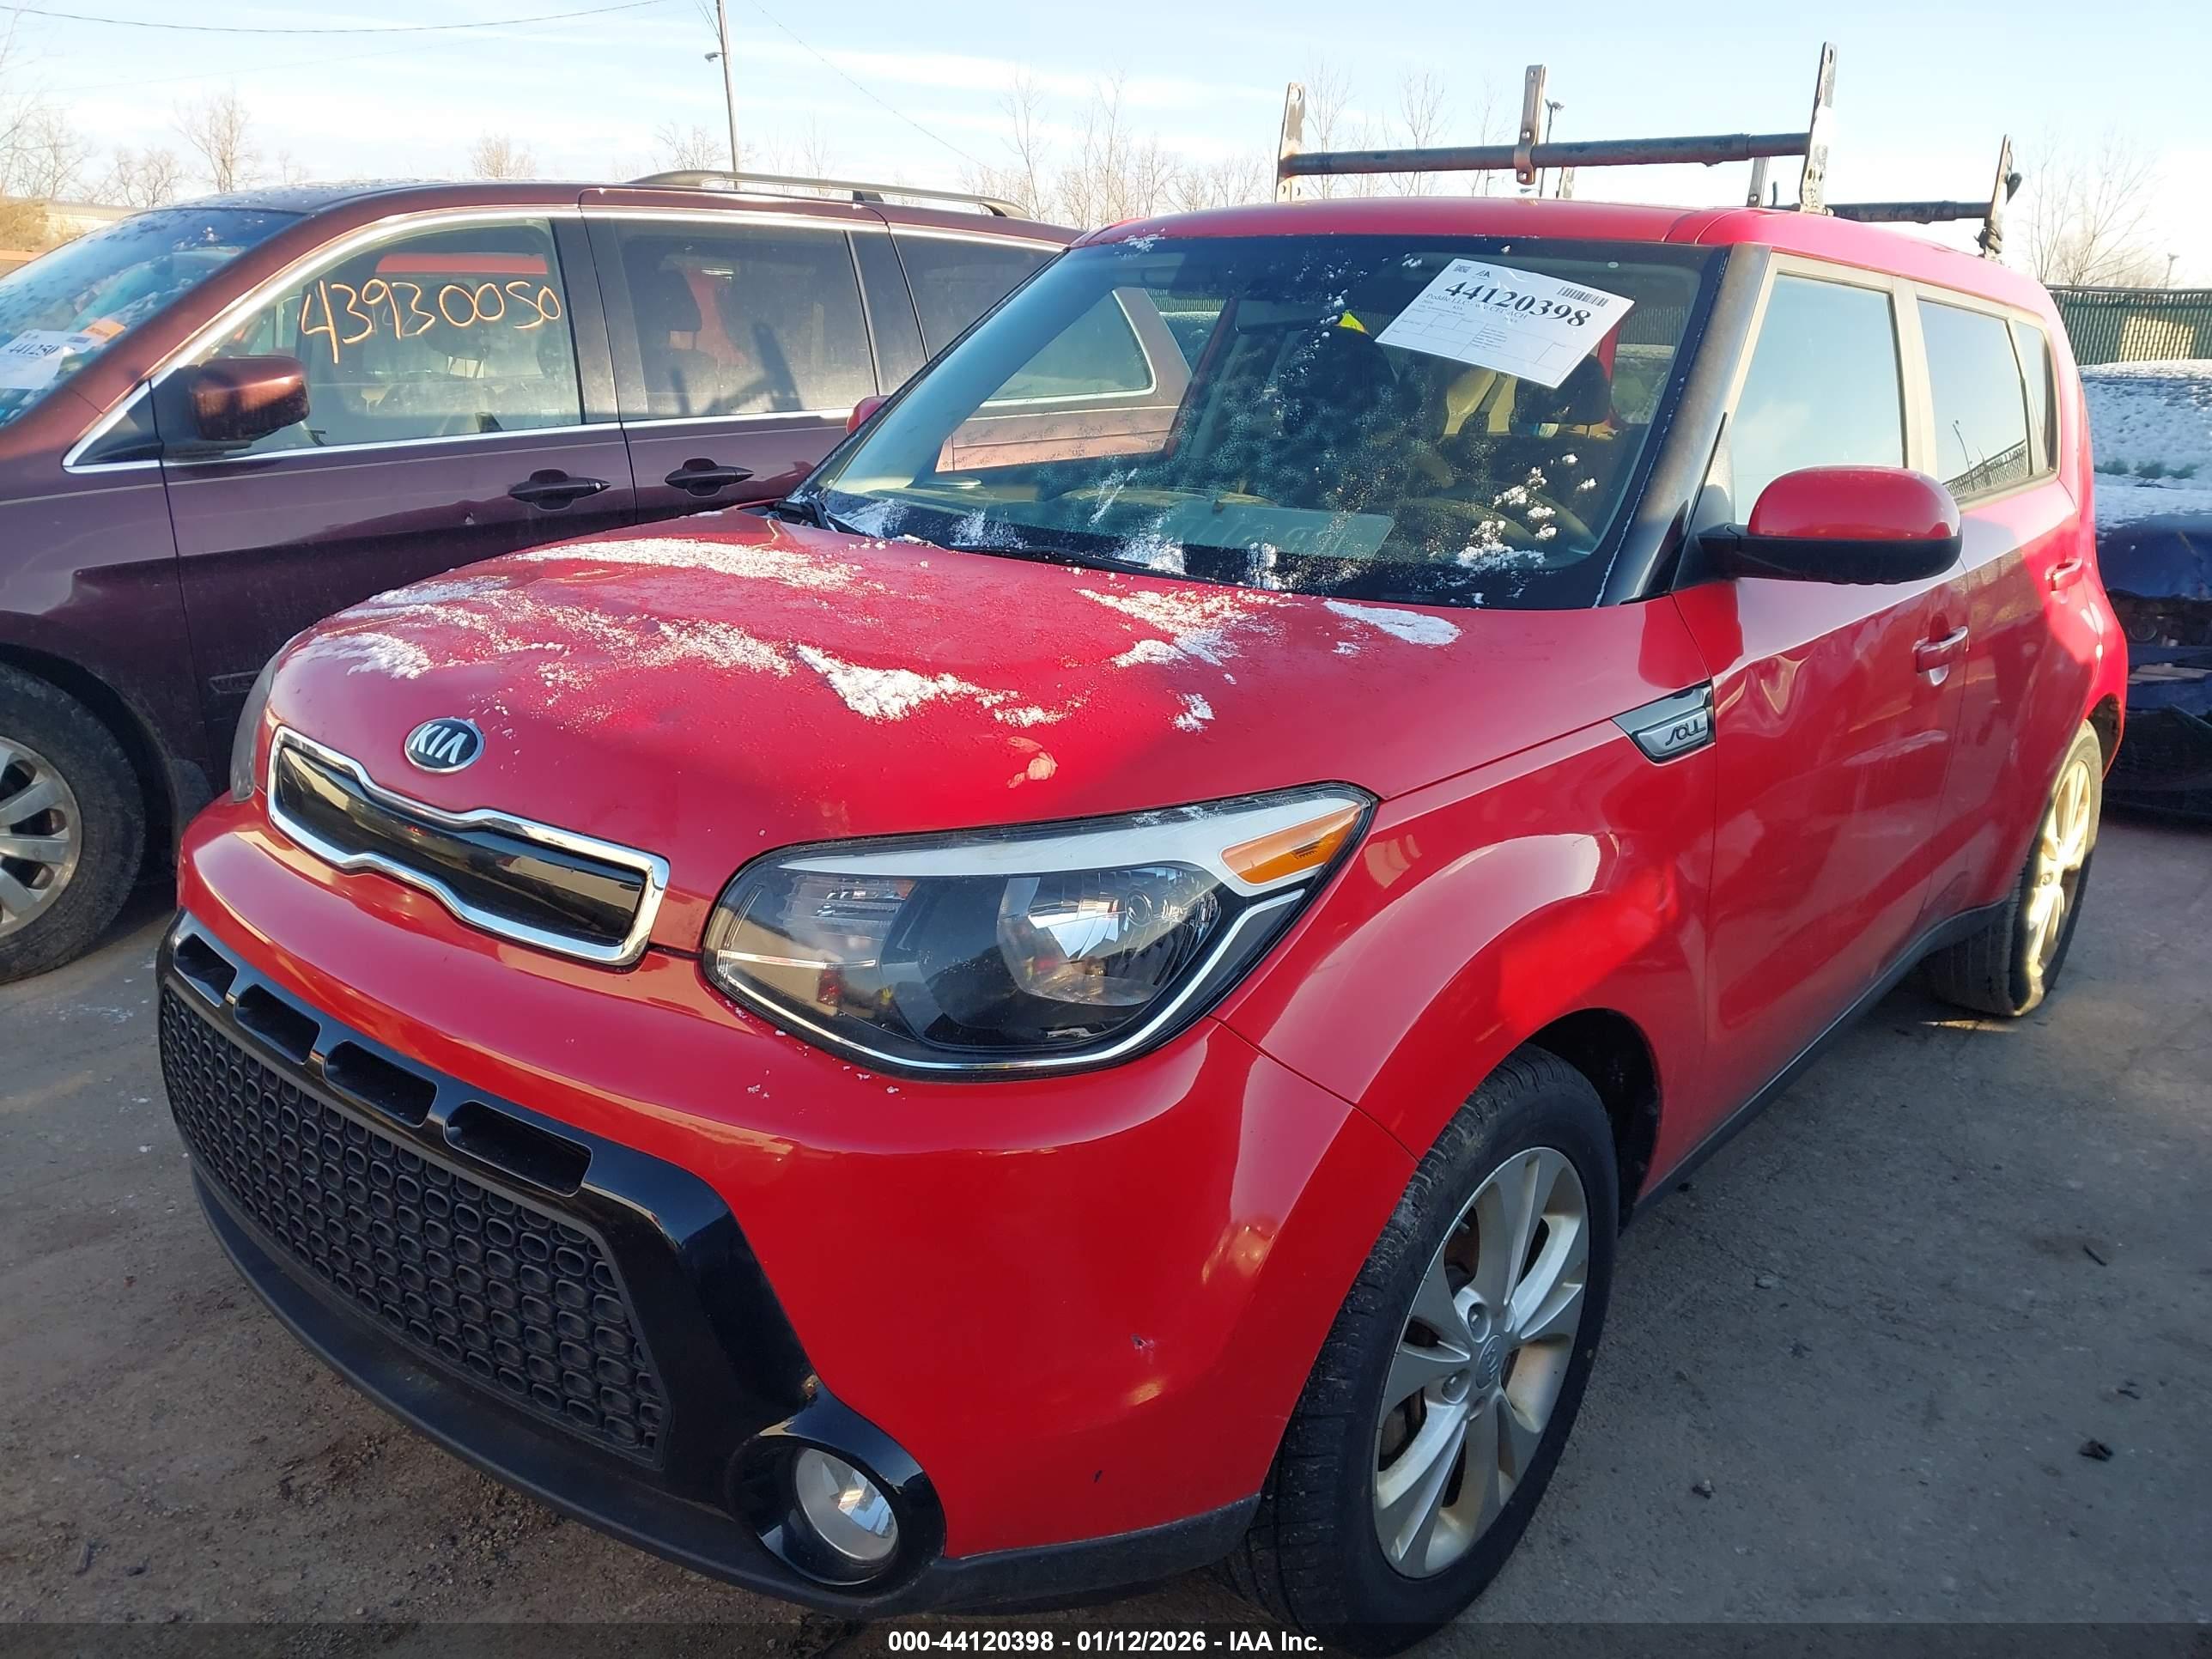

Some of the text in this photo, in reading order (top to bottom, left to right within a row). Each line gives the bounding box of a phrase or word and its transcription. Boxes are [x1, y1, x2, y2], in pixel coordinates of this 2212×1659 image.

[301, 279, 562, 364] 43930050
[1444, 281, 1592, 327] 44120398
[410, 723, 468, 764] KIA
[1664, 719, 1706, 747] SOUL
